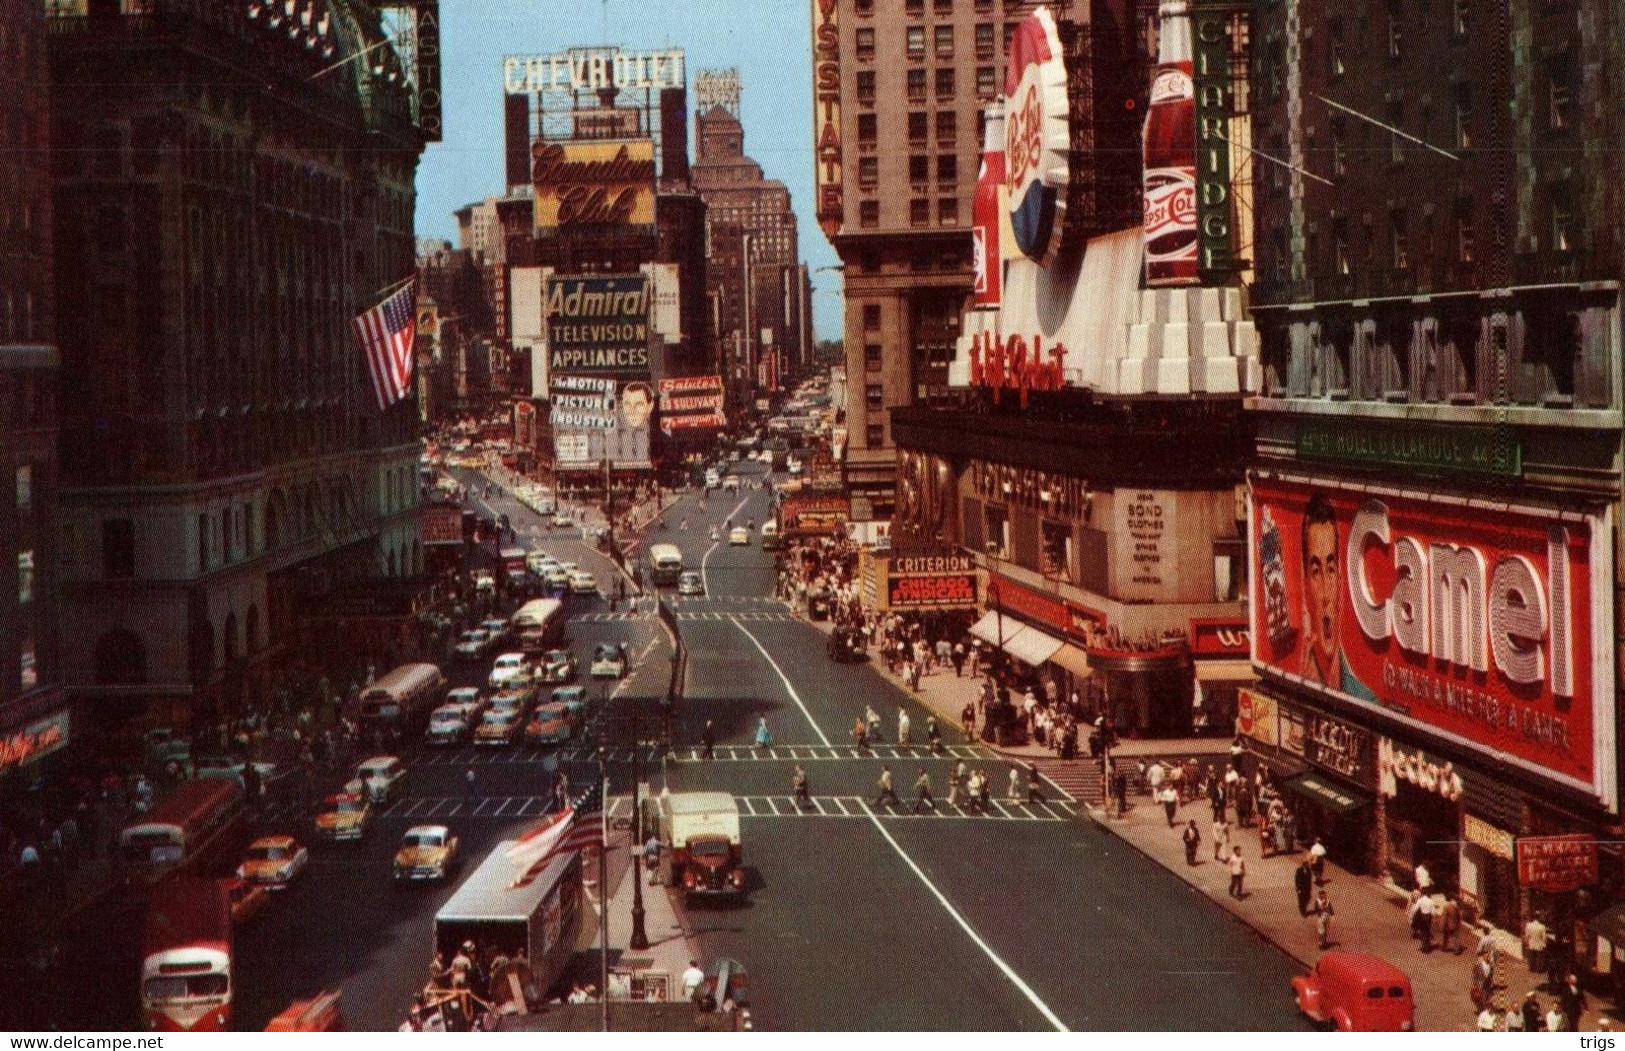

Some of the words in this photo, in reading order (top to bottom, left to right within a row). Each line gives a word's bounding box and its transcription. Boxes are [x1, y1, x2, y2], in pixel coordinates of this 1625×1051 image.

[419, 9, 440, 135] ASTOR
[505, 54, 684, 93] CHEVROLET
[818, 62, 843, 212] STATE
[1199, 20, 1228, 270] CLARIDGE
[532, 142, 655, 182] Canadian
[556, 186, 640, 224] Club
[549, 281, 650, 317] Admiral
[553, 324, 646, 342] TELEVISION
[552, 348, 648, 367] APPLIANCES
[567, 378, 615, 392] MOTION
[663, 377, 718, 391] Salutes
[557, 395, 610, 410] PICTURE
[551, 411, 615, 428] INDUSTRY
[1392, 432, 1462, 463] CLARIDGE
[1128, 504, 1162, 517] BOND
[1127, 520, 1164, 530] CLOTHES
[897, 555, 969, 572] CRITERION
[898, 577, 969, 588] CHICAGO
[892, 588, 973, 599] SYNDICATE
[1347, 499, 1573, 697] Camel
[1447, 682, 1474, 716] MILE
